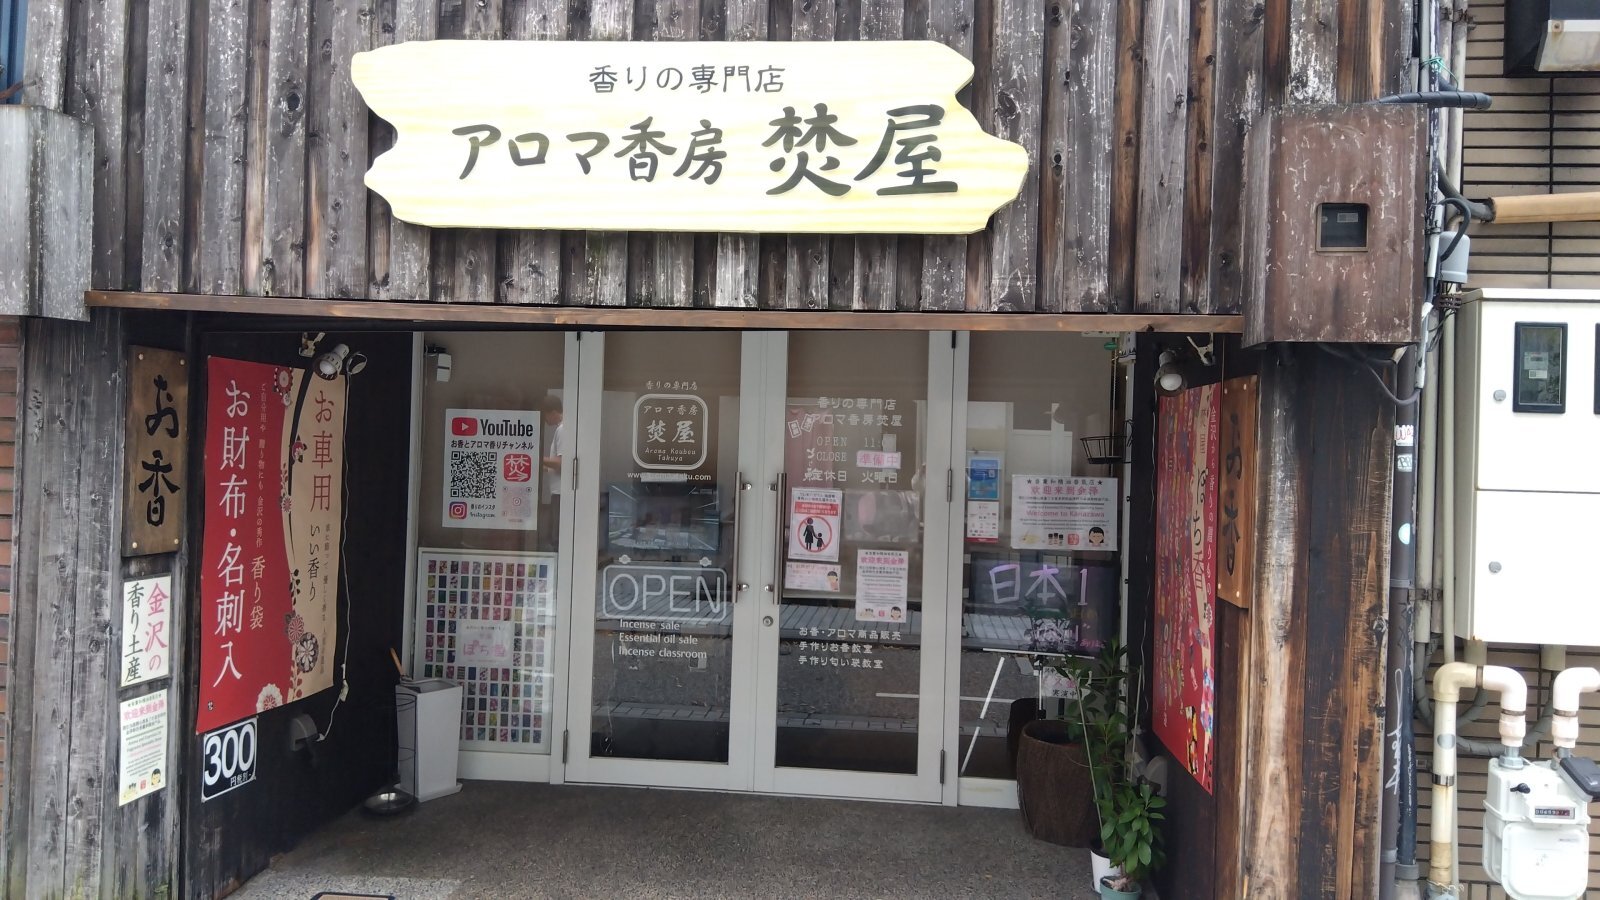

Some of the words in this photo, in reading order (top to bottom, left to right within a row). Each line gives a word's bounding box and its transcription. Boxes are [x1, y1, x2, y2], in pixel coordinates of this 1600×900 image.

[589, 64, 786, 94] 香りの専門店
[451, 116, 728, 186] アロマ香房
[762, 102, 959, 198] 焚屋
[646, 381, 698, 391] 香りの専門店
[644, 405, 699, 416] アロマ香房
[818, 397, 896, 410] 香りの専門店
[480, 419, 533, 437] YouTube
[646, 419, 695, 443] 焚屋
[138, 374, 181, 526] お香
[310, 390, 336, 513] お車用
[451, 440, 534, 451] お香とアロマ香りチャンネル
[817, 436, 848, 447] OPEN
[816, 451, 847, 462] CLOSE
[811, 469, 847, 482] 定休日
[862, 471, 897, 484] 火曜日
[213, 379, 250, 688] お財布・名刺入
[307, 523, 321, 602] いい香り
[250, 555, 266, 631] 香り袋
[609, 574, 720, 614] OPEN
[124, 580, 146, 682] 香り土産
[144, 582, 169, 672] 金沢の
[620, 618, 656, 630] Incense
[660, 620, 680, 631] sale
[619, 632, 661, 644] Essential
[663, 634, 676, 645] oil
[679, 635, 698, 646] sale
[799, 641, 873, 654] 手作りお香教室
[619, 646, 655, 657] Incense
[658, 647, 707, 659] classroom
[205, 724, 255, 786] 300
